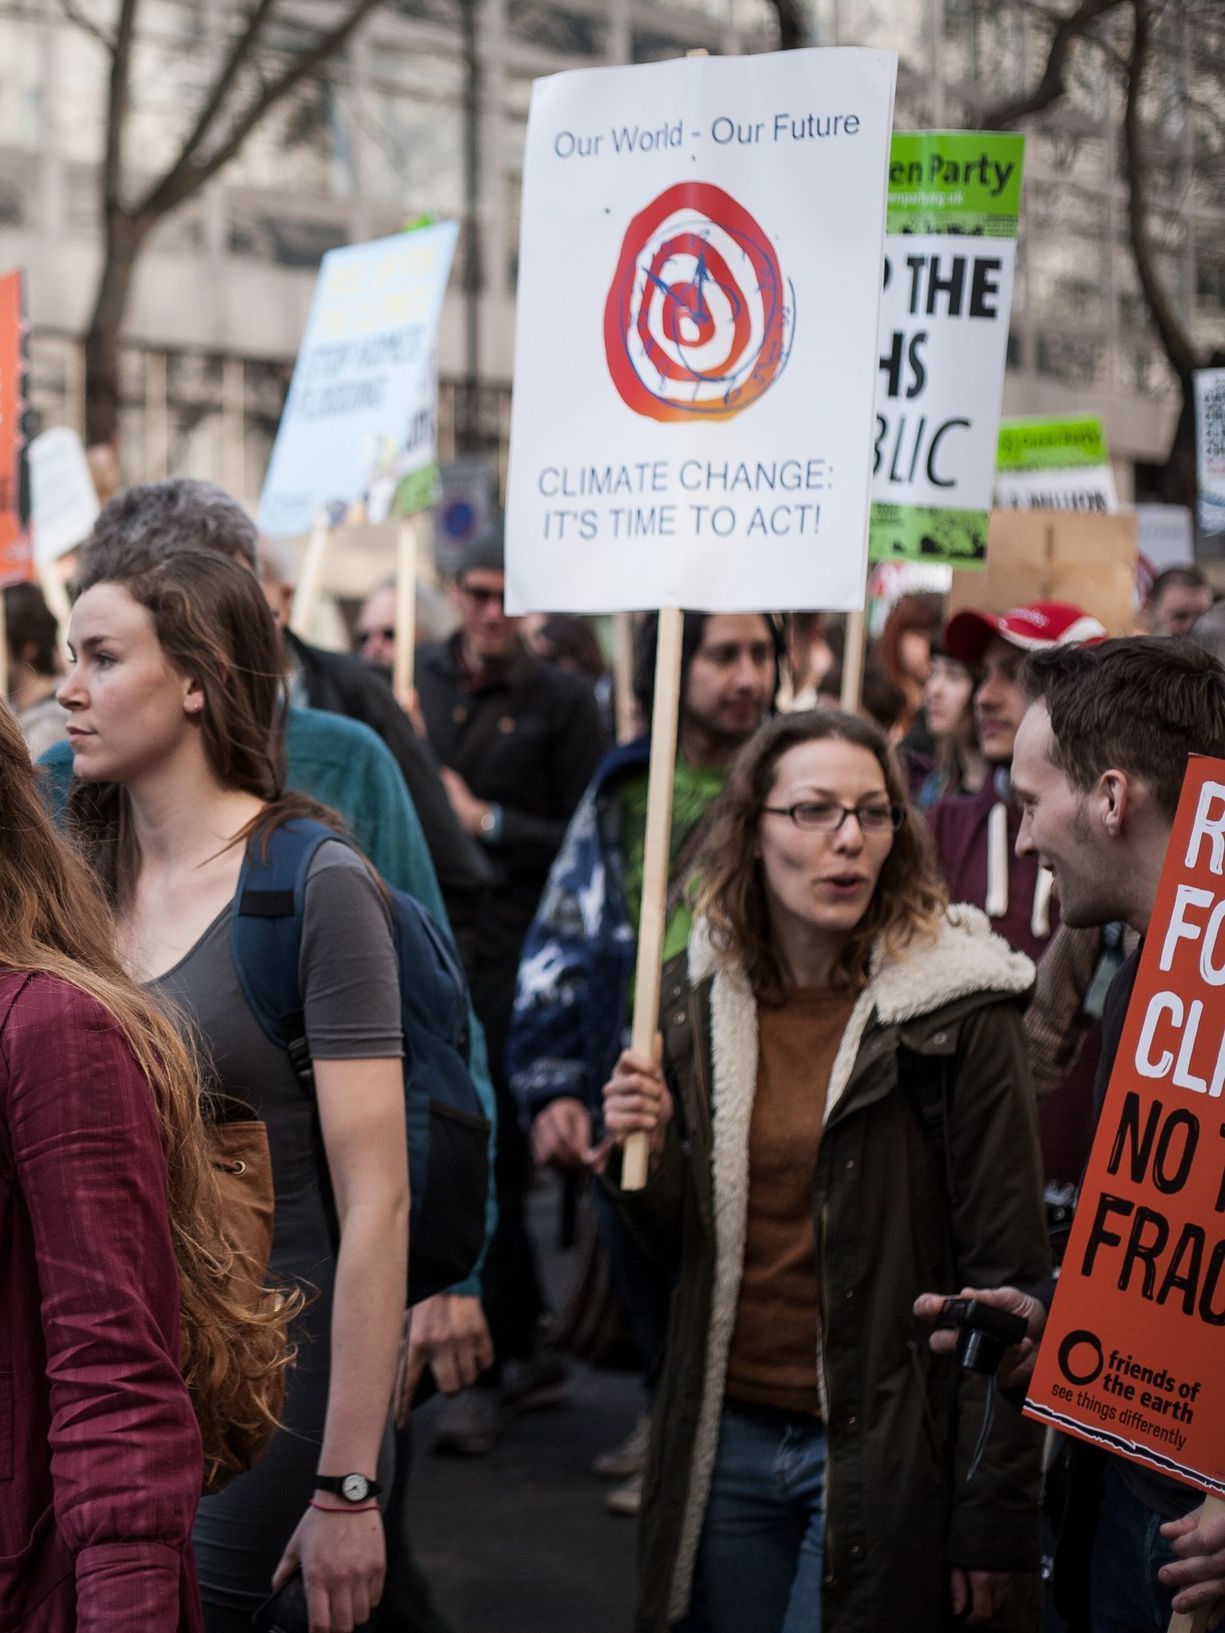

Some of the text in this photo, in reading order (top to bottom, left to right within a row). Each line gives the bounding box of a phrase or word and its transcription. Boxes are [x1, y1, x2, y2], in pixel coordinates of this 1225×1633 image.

[554, 130, 603, 158] Our
[612, 120, 683, 153] World
[711, 116, 764, 145] Our
[773, 113, 860, 142] Future
[930, 153, 1015, 197] Party
[906, 254, 1002, 319] THE
[538, 458, 834, 498] CLIMATE CHANGE:
[543, 503, 821, 540] IT'S TIME TO ACT!
[1107, 1091, 1200, 1195] NO
[1103, 1373, 1194, 1425] the earth
[1108, 1350, 1201, 1402] friends of
[1051, 1384, 1187, 1451] see things differently
